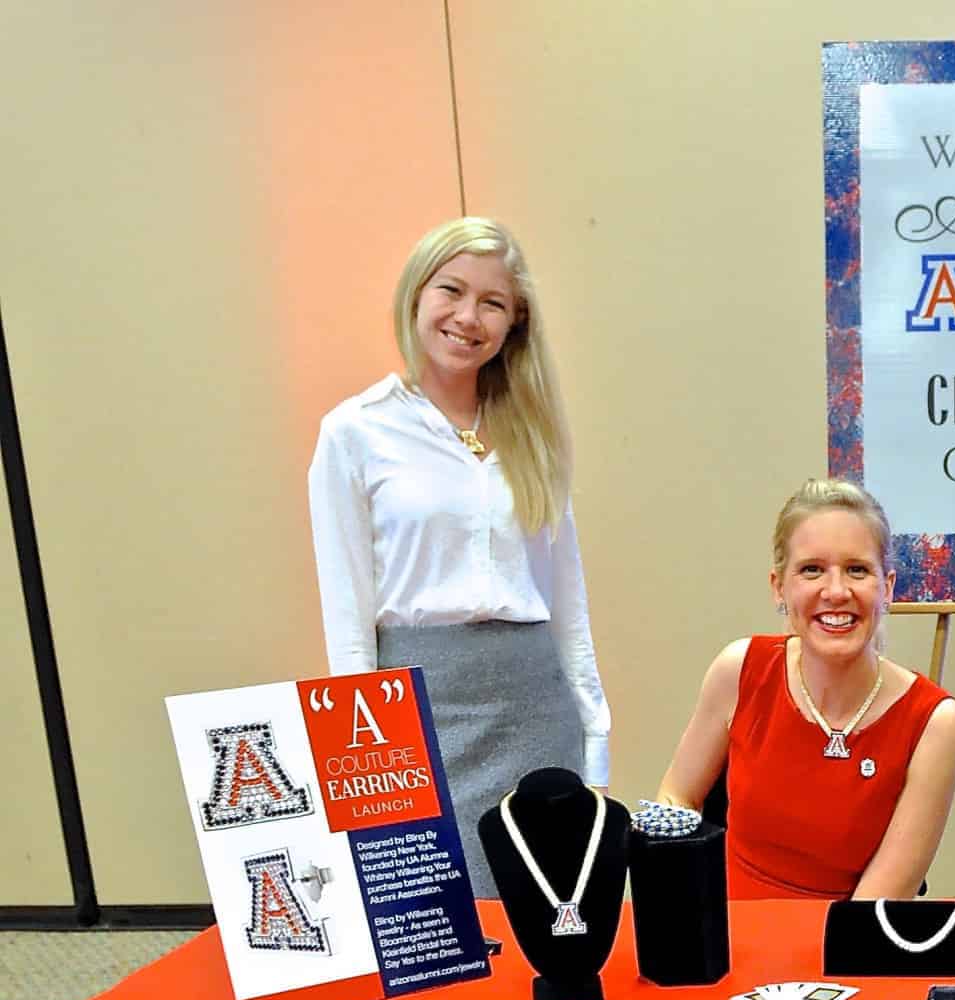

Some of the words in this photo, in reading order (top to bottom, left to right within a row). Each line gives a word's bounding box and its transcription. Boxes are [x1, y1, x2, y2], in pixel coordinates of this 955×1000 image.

[326, 746, 416, 776] COUTURE
[327, 767, 429, 801] EARRINGS
[352, 797, 414, 818] LAUNCH
[357, 837, 394, 851] Designed
[394, 837, 405, 846] by
[405, 833, 426, 843] Bling
[397, 846, 416, 855] New
[361, 860, 394, 873] founded
[395, 858, 406, 867] by
[406, 855, 420, 865] UA
[363, 872, 396, 883] Whitney
[367, 882, 403, 896] purchase
[403, 876, 434, 888] benefits
[434, 873, 447, 882] the
[448, 870, 462, 880] UA
[370, 893, 396, 905] Alumni
[374, 915, 395, 926] Bling
[395, 914, 406, 923] by
[410, 922, 421, 931] As
[422, 919, 440, 929] seen
[441, 916, 450, 925] in
[438, 925, 453, 936] and
[416, 940, 439, 951] Bridal
[439, 937, 458, 947] from
[384, 960, 400, 969] Say
[400, 956, 416, 966] Yes
[416, 954, 424, 962] to
[425, 952, 439, 961] the
